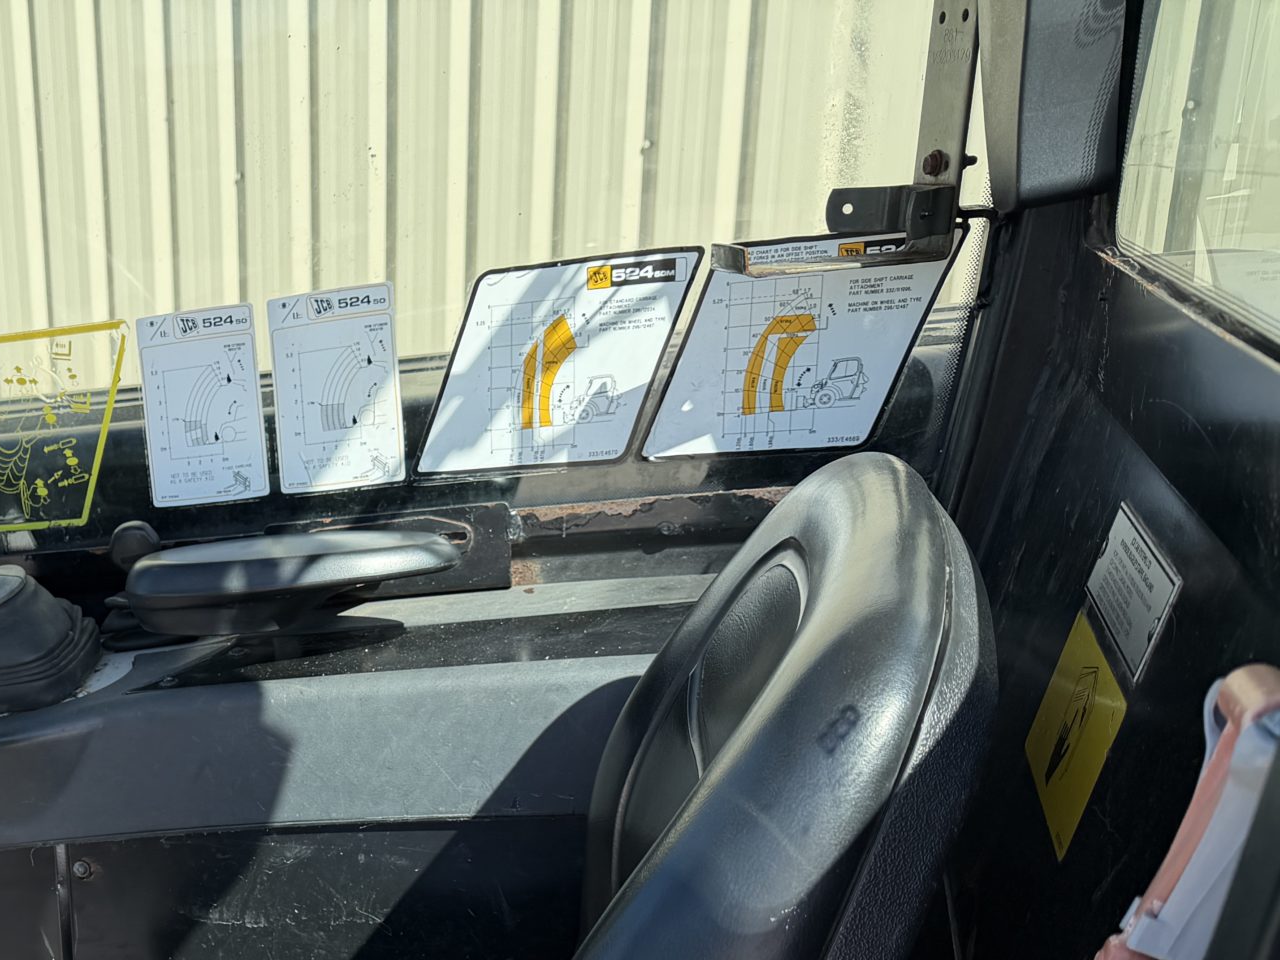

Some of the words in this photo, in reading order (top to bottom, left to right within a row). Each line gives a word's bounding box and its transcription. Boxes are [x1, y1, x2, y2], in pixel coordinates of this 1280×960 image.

[314, 299, 333, 314] JCB
[338, 295, 371, 309] 524
[180, 318, 198, 333] JCB
[202, 315, 234, 328] 524
